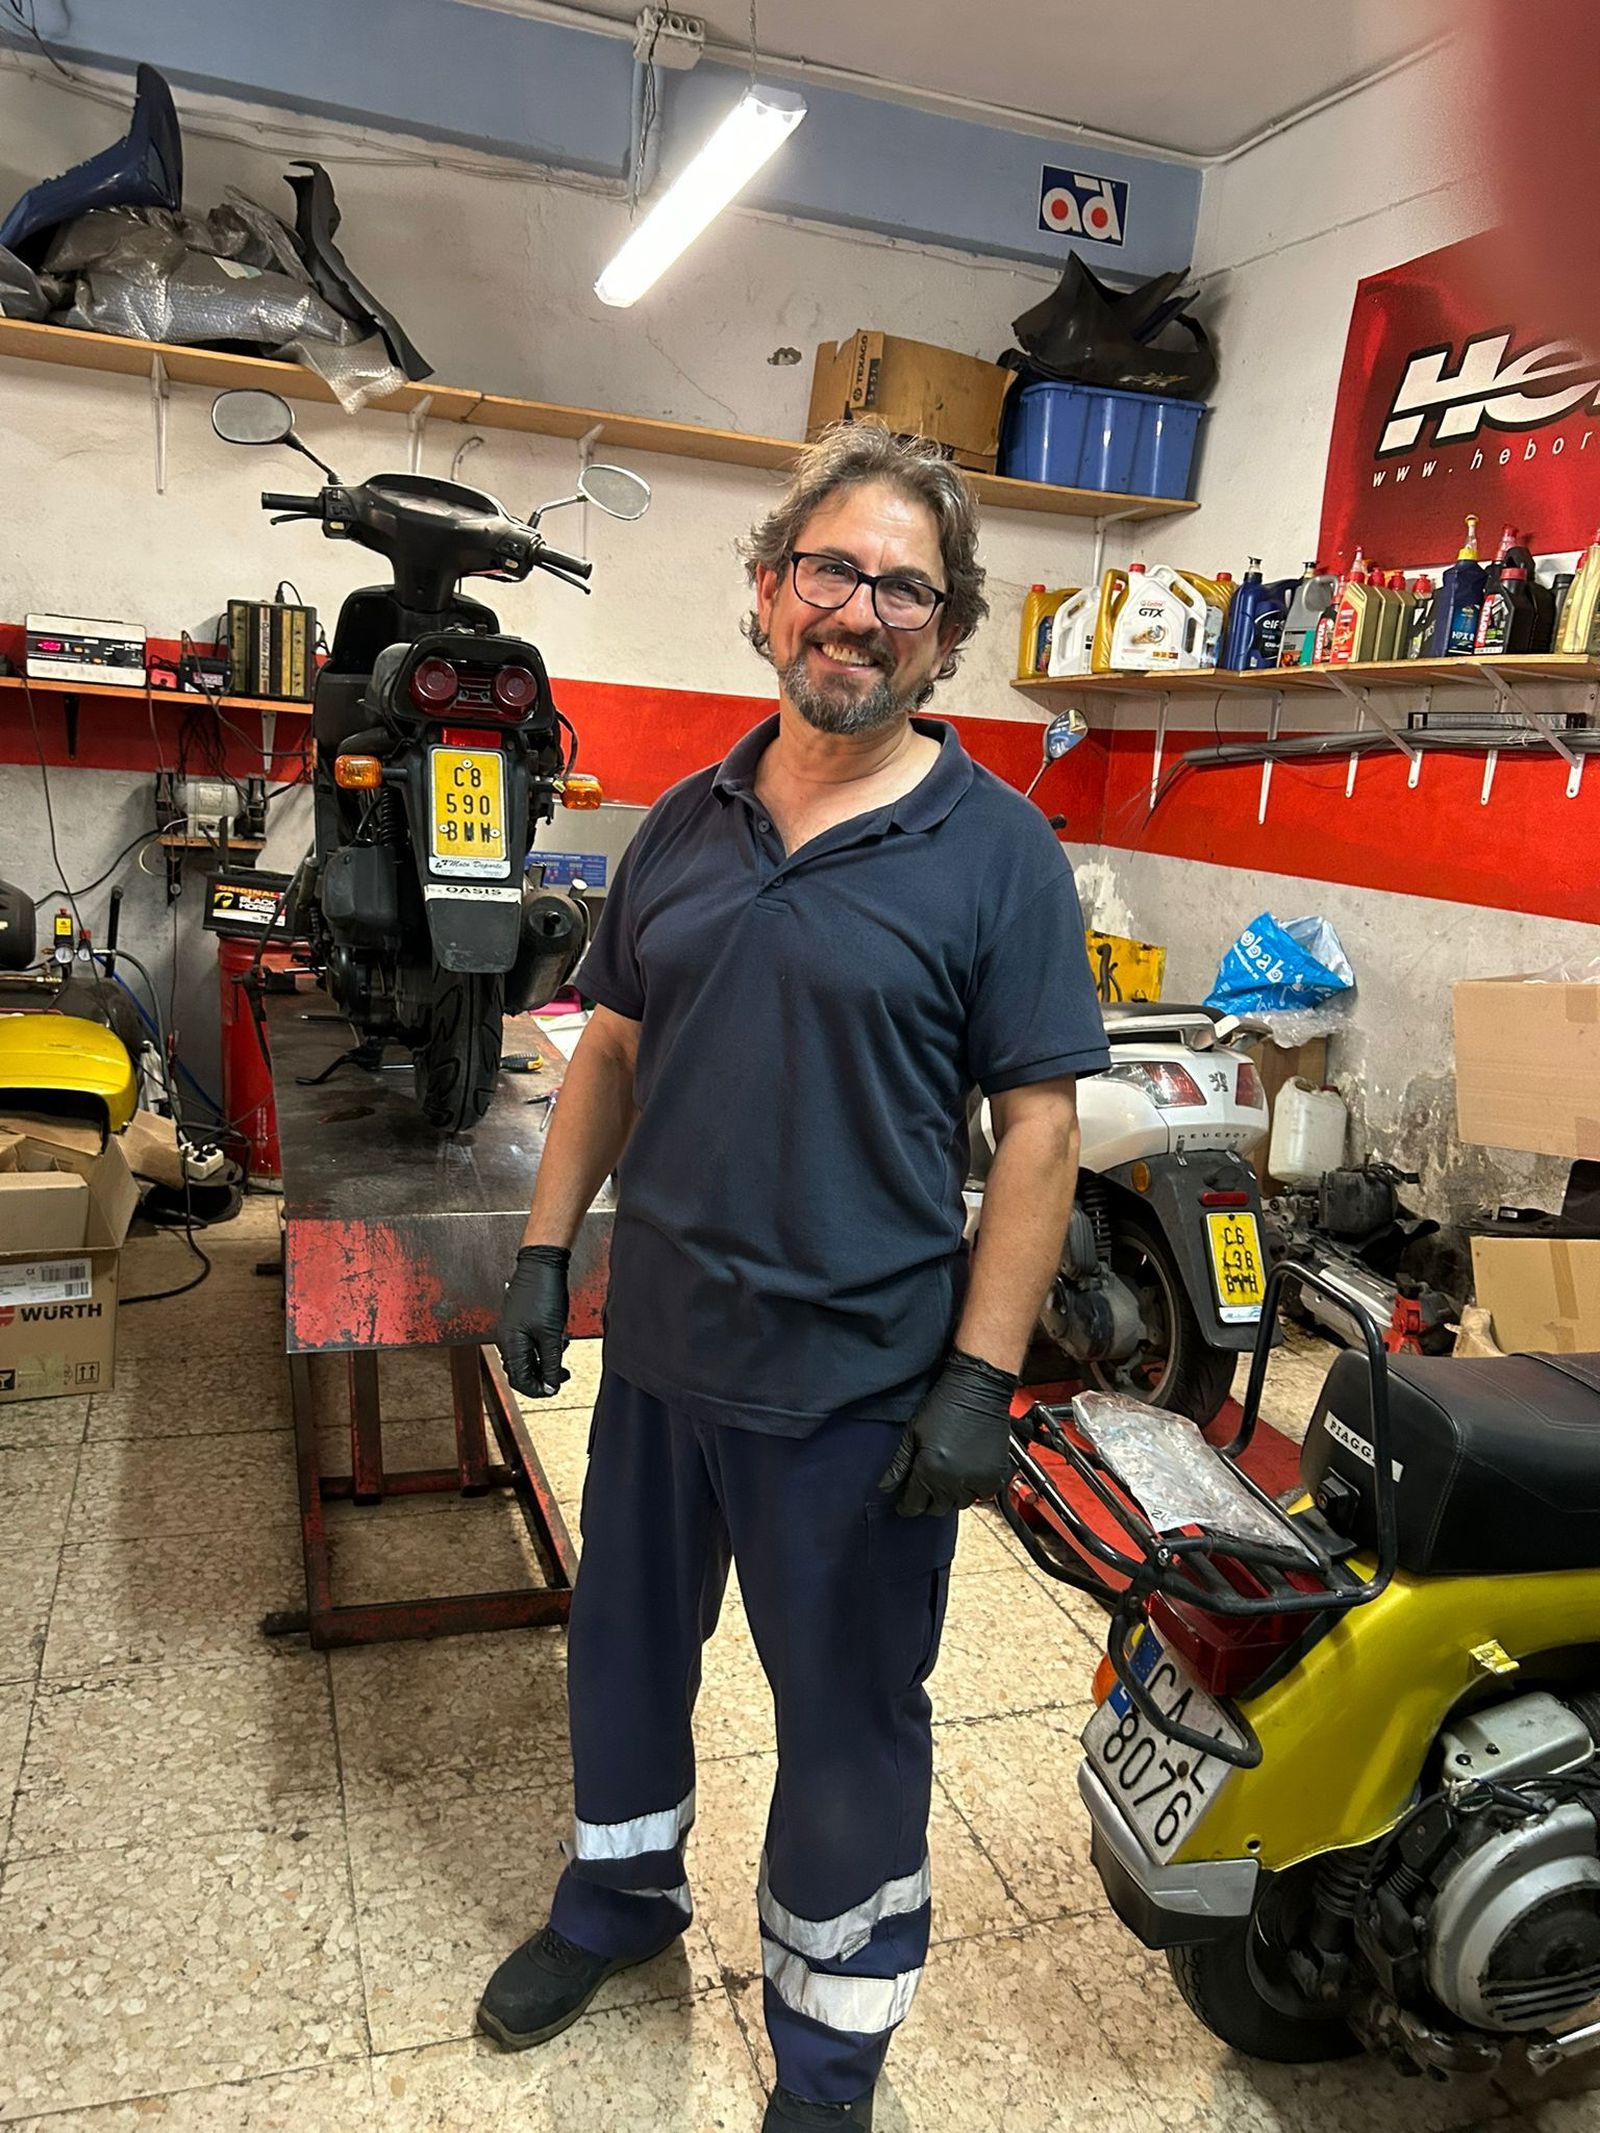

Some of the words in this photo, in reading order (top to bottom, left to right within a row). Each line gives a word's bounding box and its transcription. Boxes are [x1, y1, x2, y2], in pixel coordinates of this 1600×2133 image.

[856, 335, 868, 384] TEXACO
[1138, 607, 1165, 618] GTX
[1477, 601, 1493, 643] MOTUL
[1262, 619, 1280, 629] elf
[1315, 622, 1326, 660] MOTUL
[454, 767, 481, 788] C8
[446, 793, 490, 815] 590
[218, 884, 279, 898] ORIGINAL
[240, 895, 276, 905] BLACK
[446, 886, 502, 896] OASIS
[20, 1303, 103, 1322] WÜRTH
[1329, 1421, 1374, 1461] PIAGG
[1103, 1712, 1192, 1847] 8076
